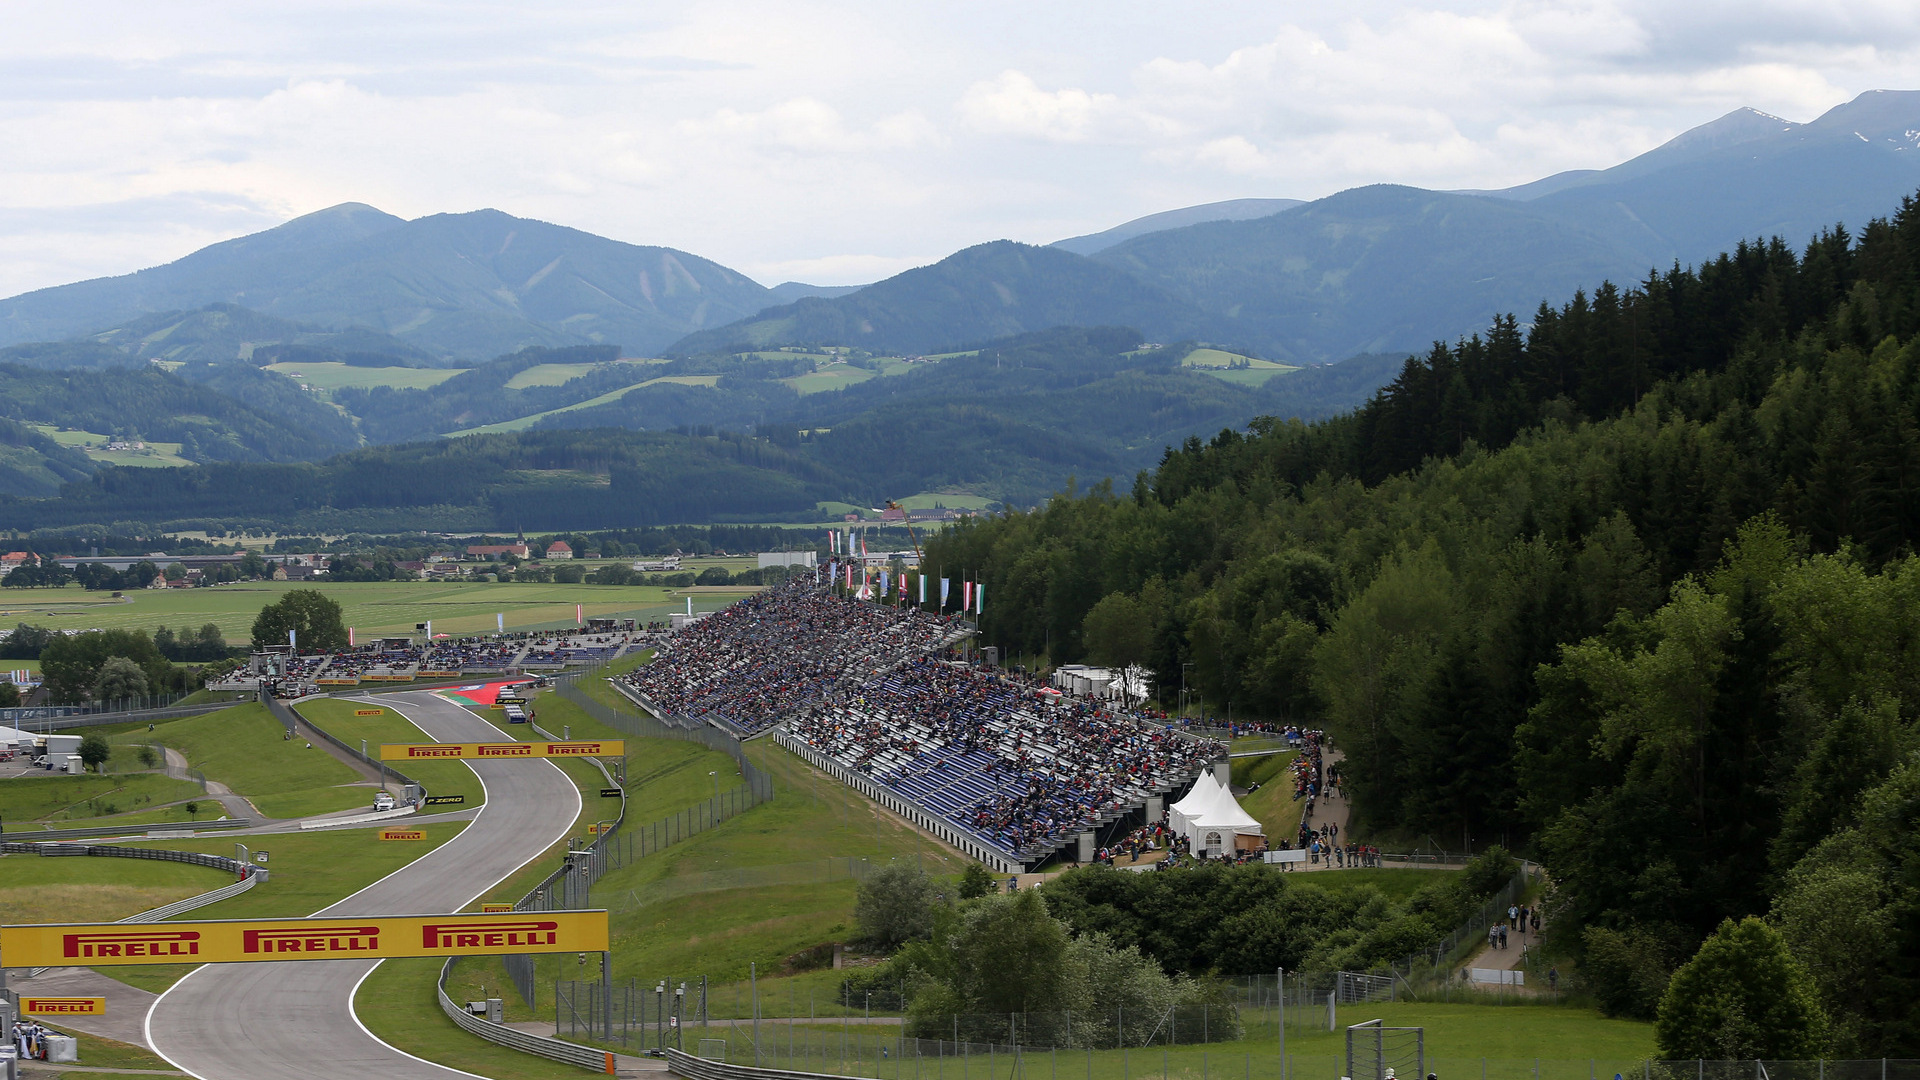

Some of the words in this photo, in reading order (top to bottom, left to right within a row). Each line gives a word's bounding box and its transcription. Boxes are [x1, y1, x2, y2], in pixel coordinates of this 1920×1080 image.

[408, 746, 462, 757] PIRELLI
[478, 745, 531, 756] PIRELLI
[548, 744, 601, 755] PIRELLI
[63, 931, 200, 958] PIRELLI
[243, 926, 380, 953] PIRELLI
[422, 921, 558, 949] PIRELLI
[28, 1000, 94, 1012] PIRELLI
